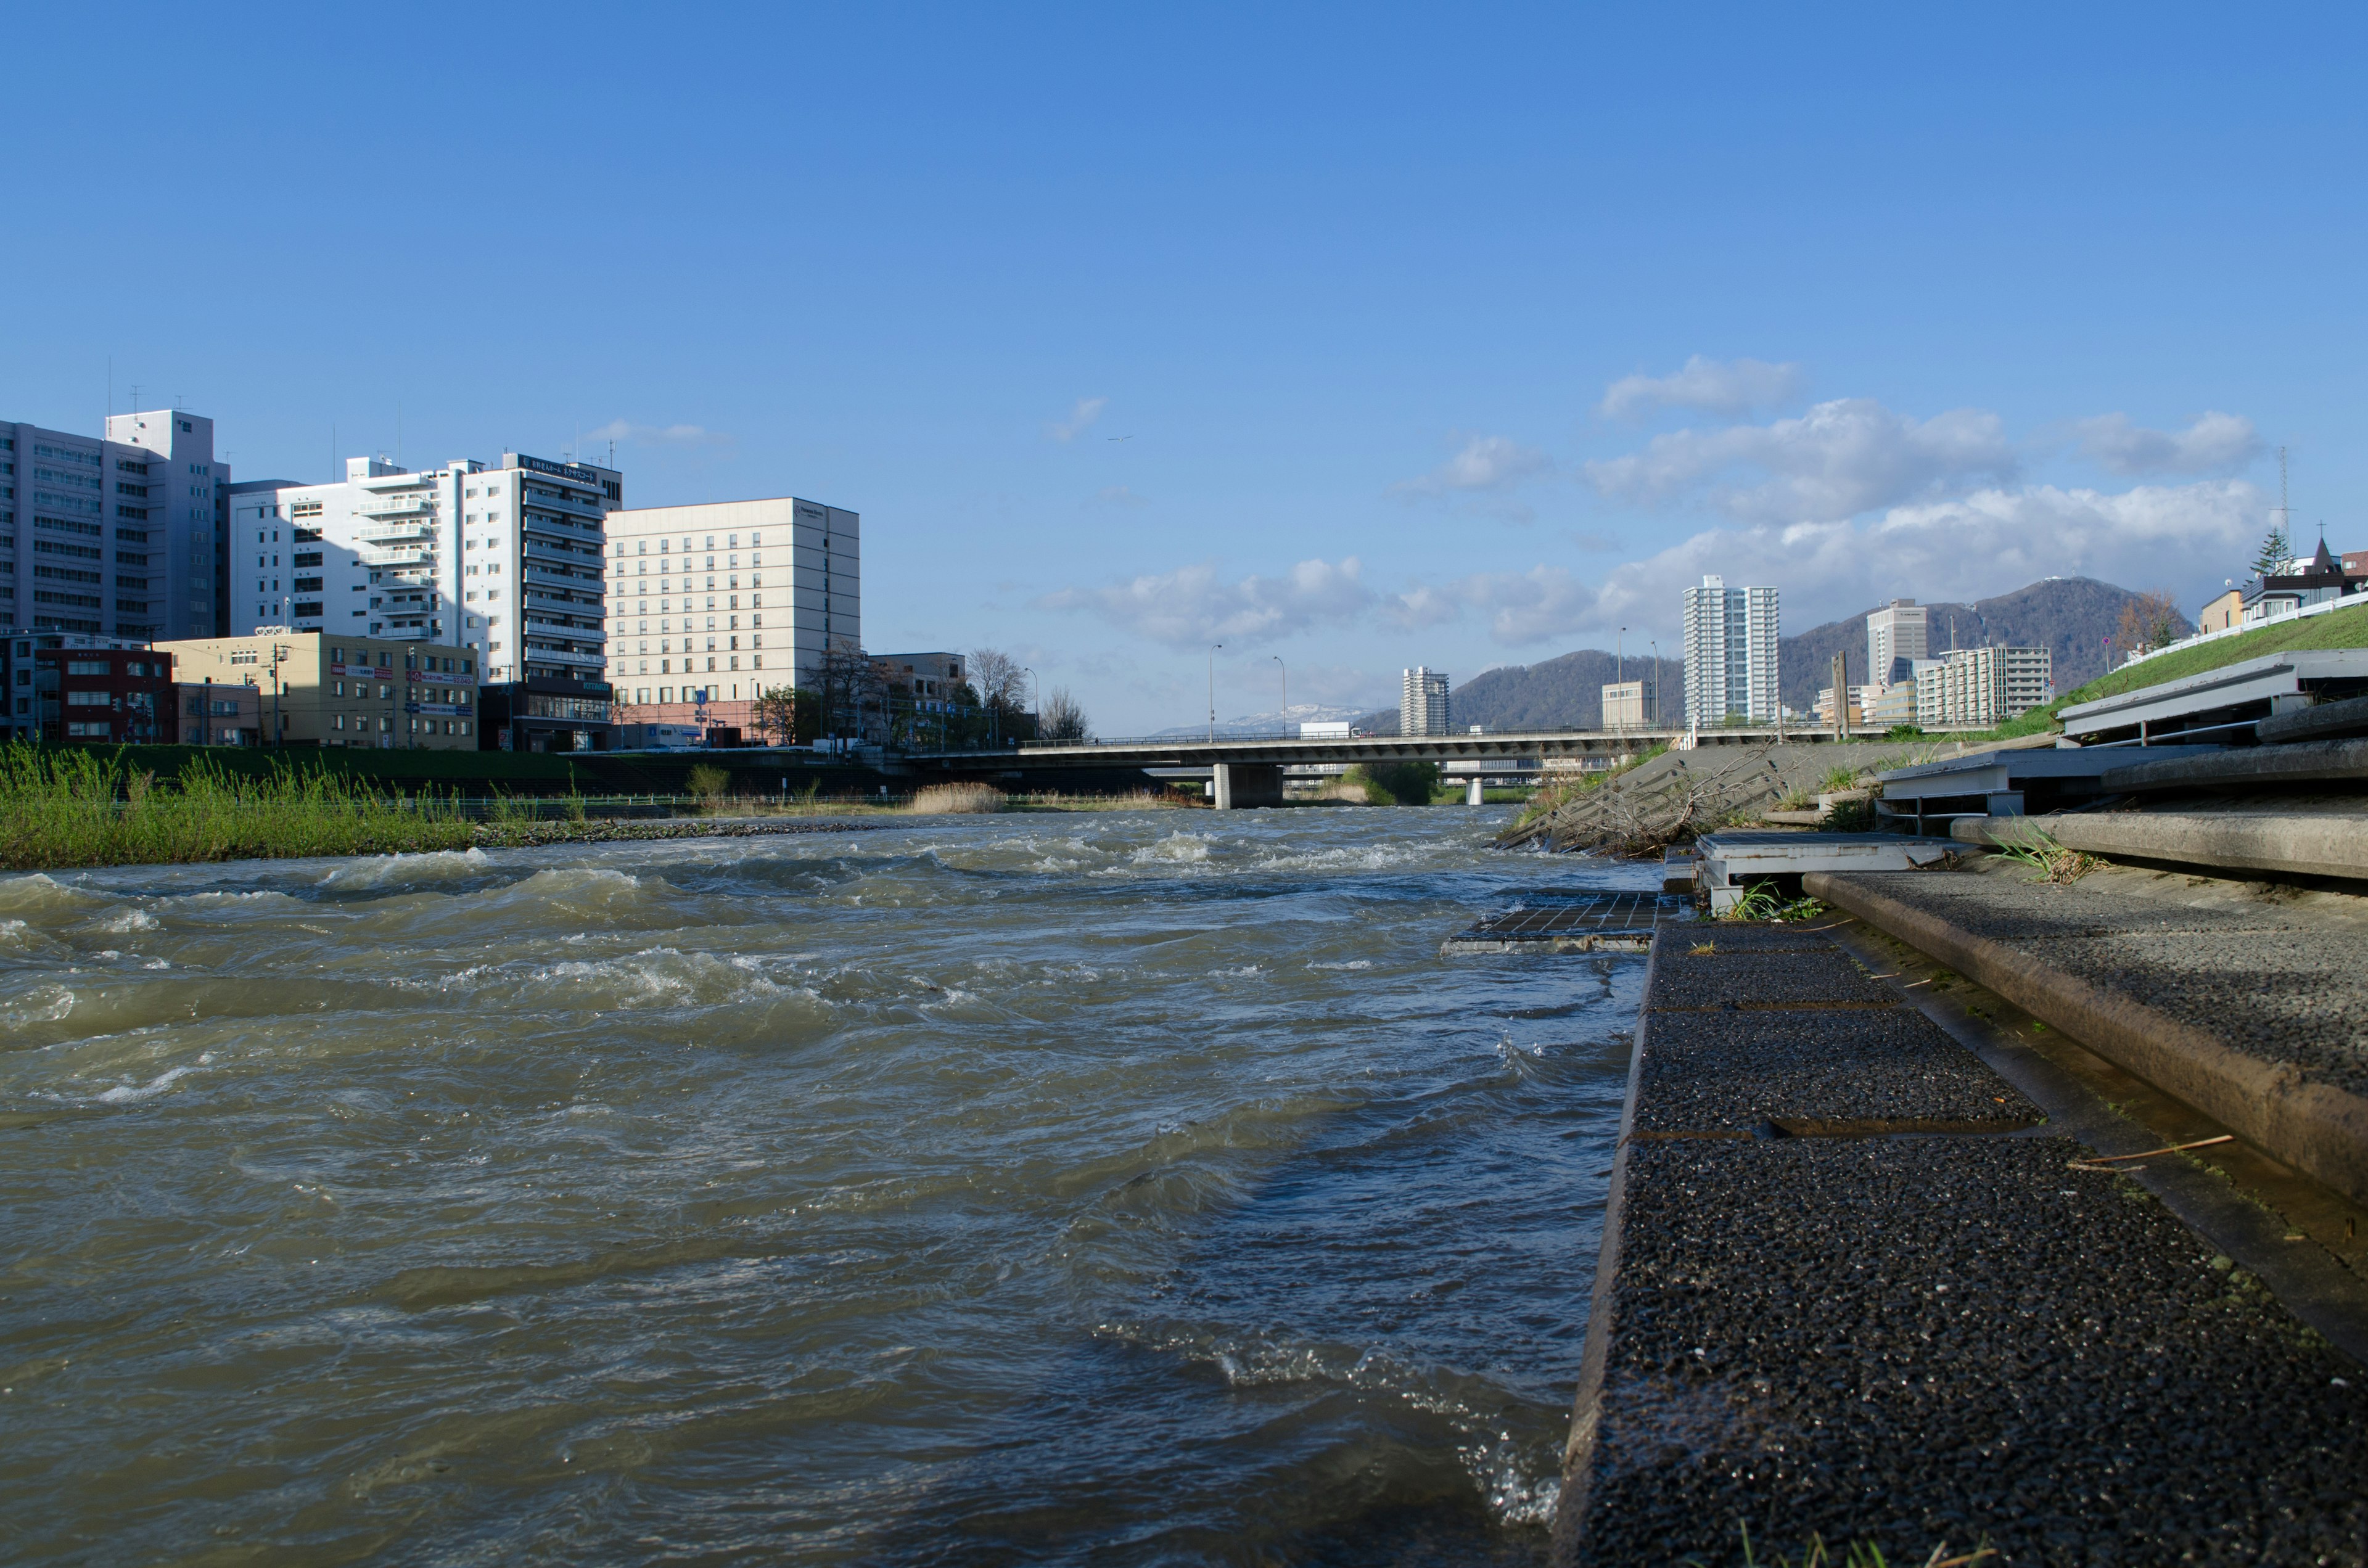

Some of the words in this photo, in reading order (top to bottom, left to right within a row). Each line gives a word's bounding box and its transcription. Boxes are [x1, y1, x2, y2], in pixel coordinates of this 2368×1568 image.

[564, 467, 594, 482] ネクサスコート
